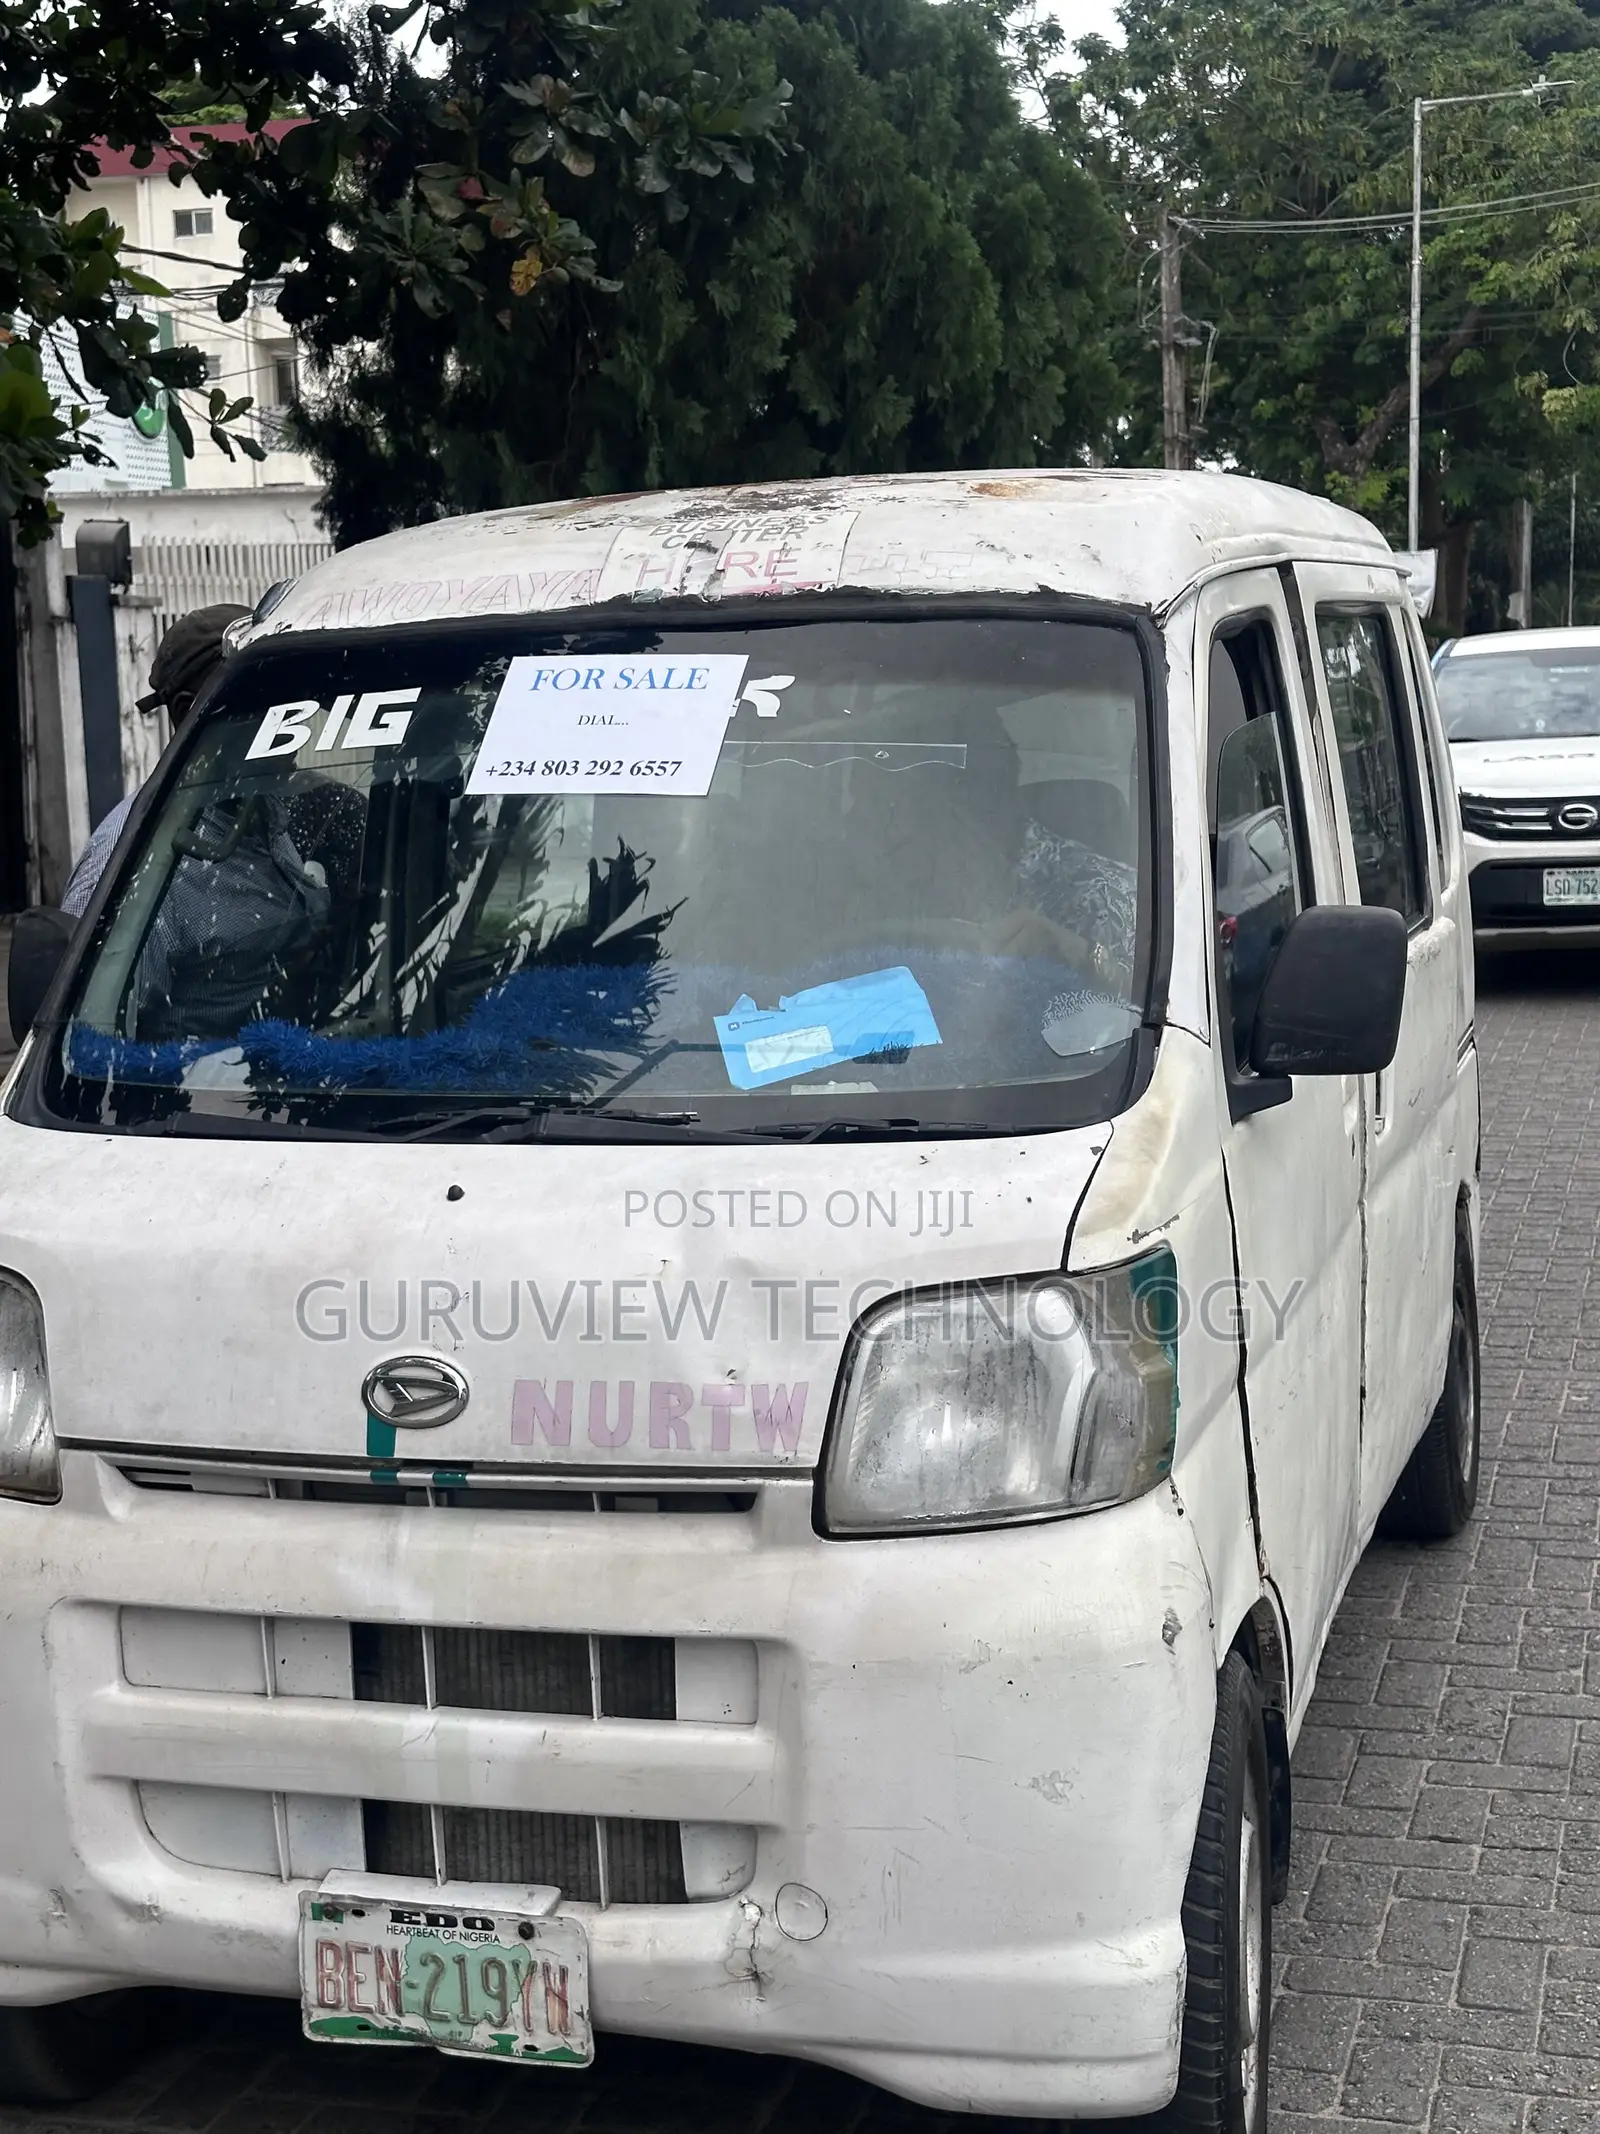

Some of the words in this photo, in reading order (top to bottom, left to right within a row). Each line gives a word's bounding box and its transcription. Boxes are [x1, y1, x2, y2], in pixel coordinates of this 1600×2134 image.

[649, 513, 832, 536] BUSINESS
[661, 525, 810, 550] CETER
[635, 549, 799, 587] HRE
[529, 668, 606, 691] FOR
[613, 667, 709, 690] SALE
[245, 687, 422, 760] BIG
[577, 714, 629, 726] DIAL...
[486, 760, 536, 777] +234
[541, 760, 579, 777] 803
[584, 759, 622, 777] 292
[629, 760, 683, 777] 6557
[510, 1379, 809, 1452] NURTW
[390, 1909, 495, 1931] EDO
[386, 1924, 440, 1939] HEARTBEAT
[442, 1929, 458, 1940] OF
[459, 1931, 501, 1944] NIGERIA
